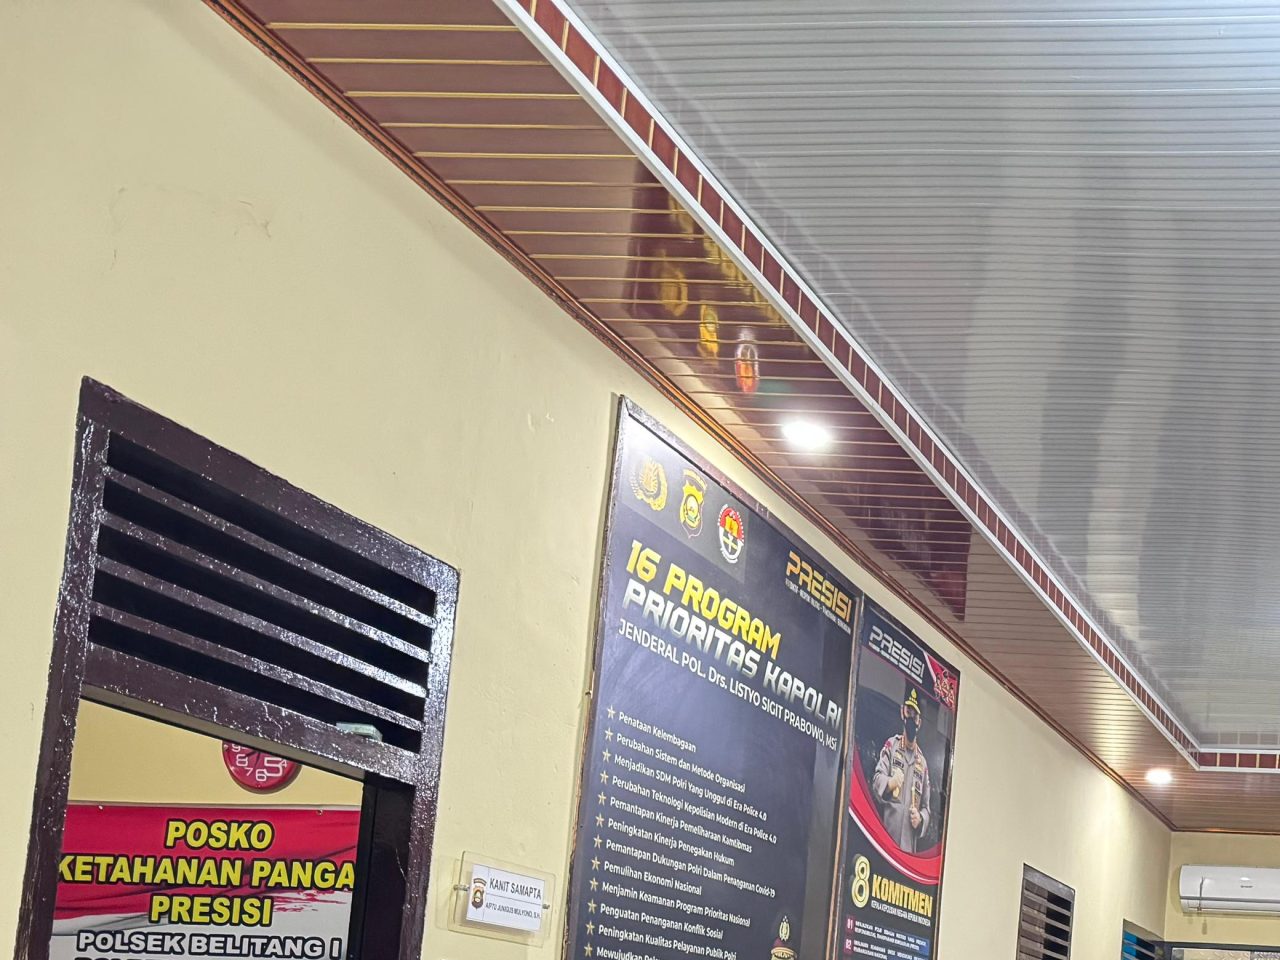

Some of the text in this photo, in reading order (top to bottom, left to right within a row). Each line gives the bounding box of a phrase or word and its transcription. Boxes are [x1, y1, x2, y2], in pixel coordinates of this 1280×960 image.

[626, 539, 662, 583] 16
[662, 563, 782, 661] PROGRAM
[785, 550, 852, 623] PRESISI
[622, 578, 763, 679] PRIORITAS
[763, 661, 843, 730] KAPOLRI
[869, 625, 925, 678] PRESISI
[618, 619, 680, 665] JENDERAL
[681, 655, 707, 679] POL.
[708, 666, 728, 690] Drs.
[729, 677, 761, 706] LISTYO
[761, 696, 784, 719] SIGIT
[784, 709, 826, 746] PRABOWO,
[618, 711, 697, 753] Penataan Kelembagaan
[614, 754, 767, 821] Menjadikan SDM Polri Yang Unggul di Era Police 4.0
[616, 733, 746, 793] Perubahan Sistem dan Metode Organisasi
[166, 821, 272, 848] POSKO
[610, 797, 753, 854] Pemantapan Kinerja Pemeliharaan Kamtibmas
[612, 776, 777, 844] Perubahan Teknologi Kepolisian Modern di Era Police 4.0
[608, 818, 735, 866] Peningkatan Kinerja Penegakan Hukum
[59, 855, 241, 886] KETAHANAN
[489, 878, 541, 900] KANIT SAMAPTA
[604, 861, 703, 896] Pemulihan Ekonomi Nasional
[606, 840, 651, 862] Pemantapan
[652, 852, 687, 872] Dukungan
[687, 862, 703, 874] Polri
[703, 866, 723, 882] Dalam
[755, 884, 776, 898] Covid-19
[851, 855, 871, 908] 8
[871, 874, 933, 917] KOMITMEN
[150, 897, 271, 925] PRESISI
[600, 903, 724, 940] Penguatan Penanganan Konflik Sosial
[602, 882, 751, 927] Menjamin Keamanan Program Prioritas Nasional
[79, 933, 340, 959] POLSEK BELITANG I
[598, 924, 644, 943] Peningkatan
[645, 934, 672, 949] Kualitas
[673, 940, 705, 956] Pelayanan
[705, 947, 724, 959] Publik
